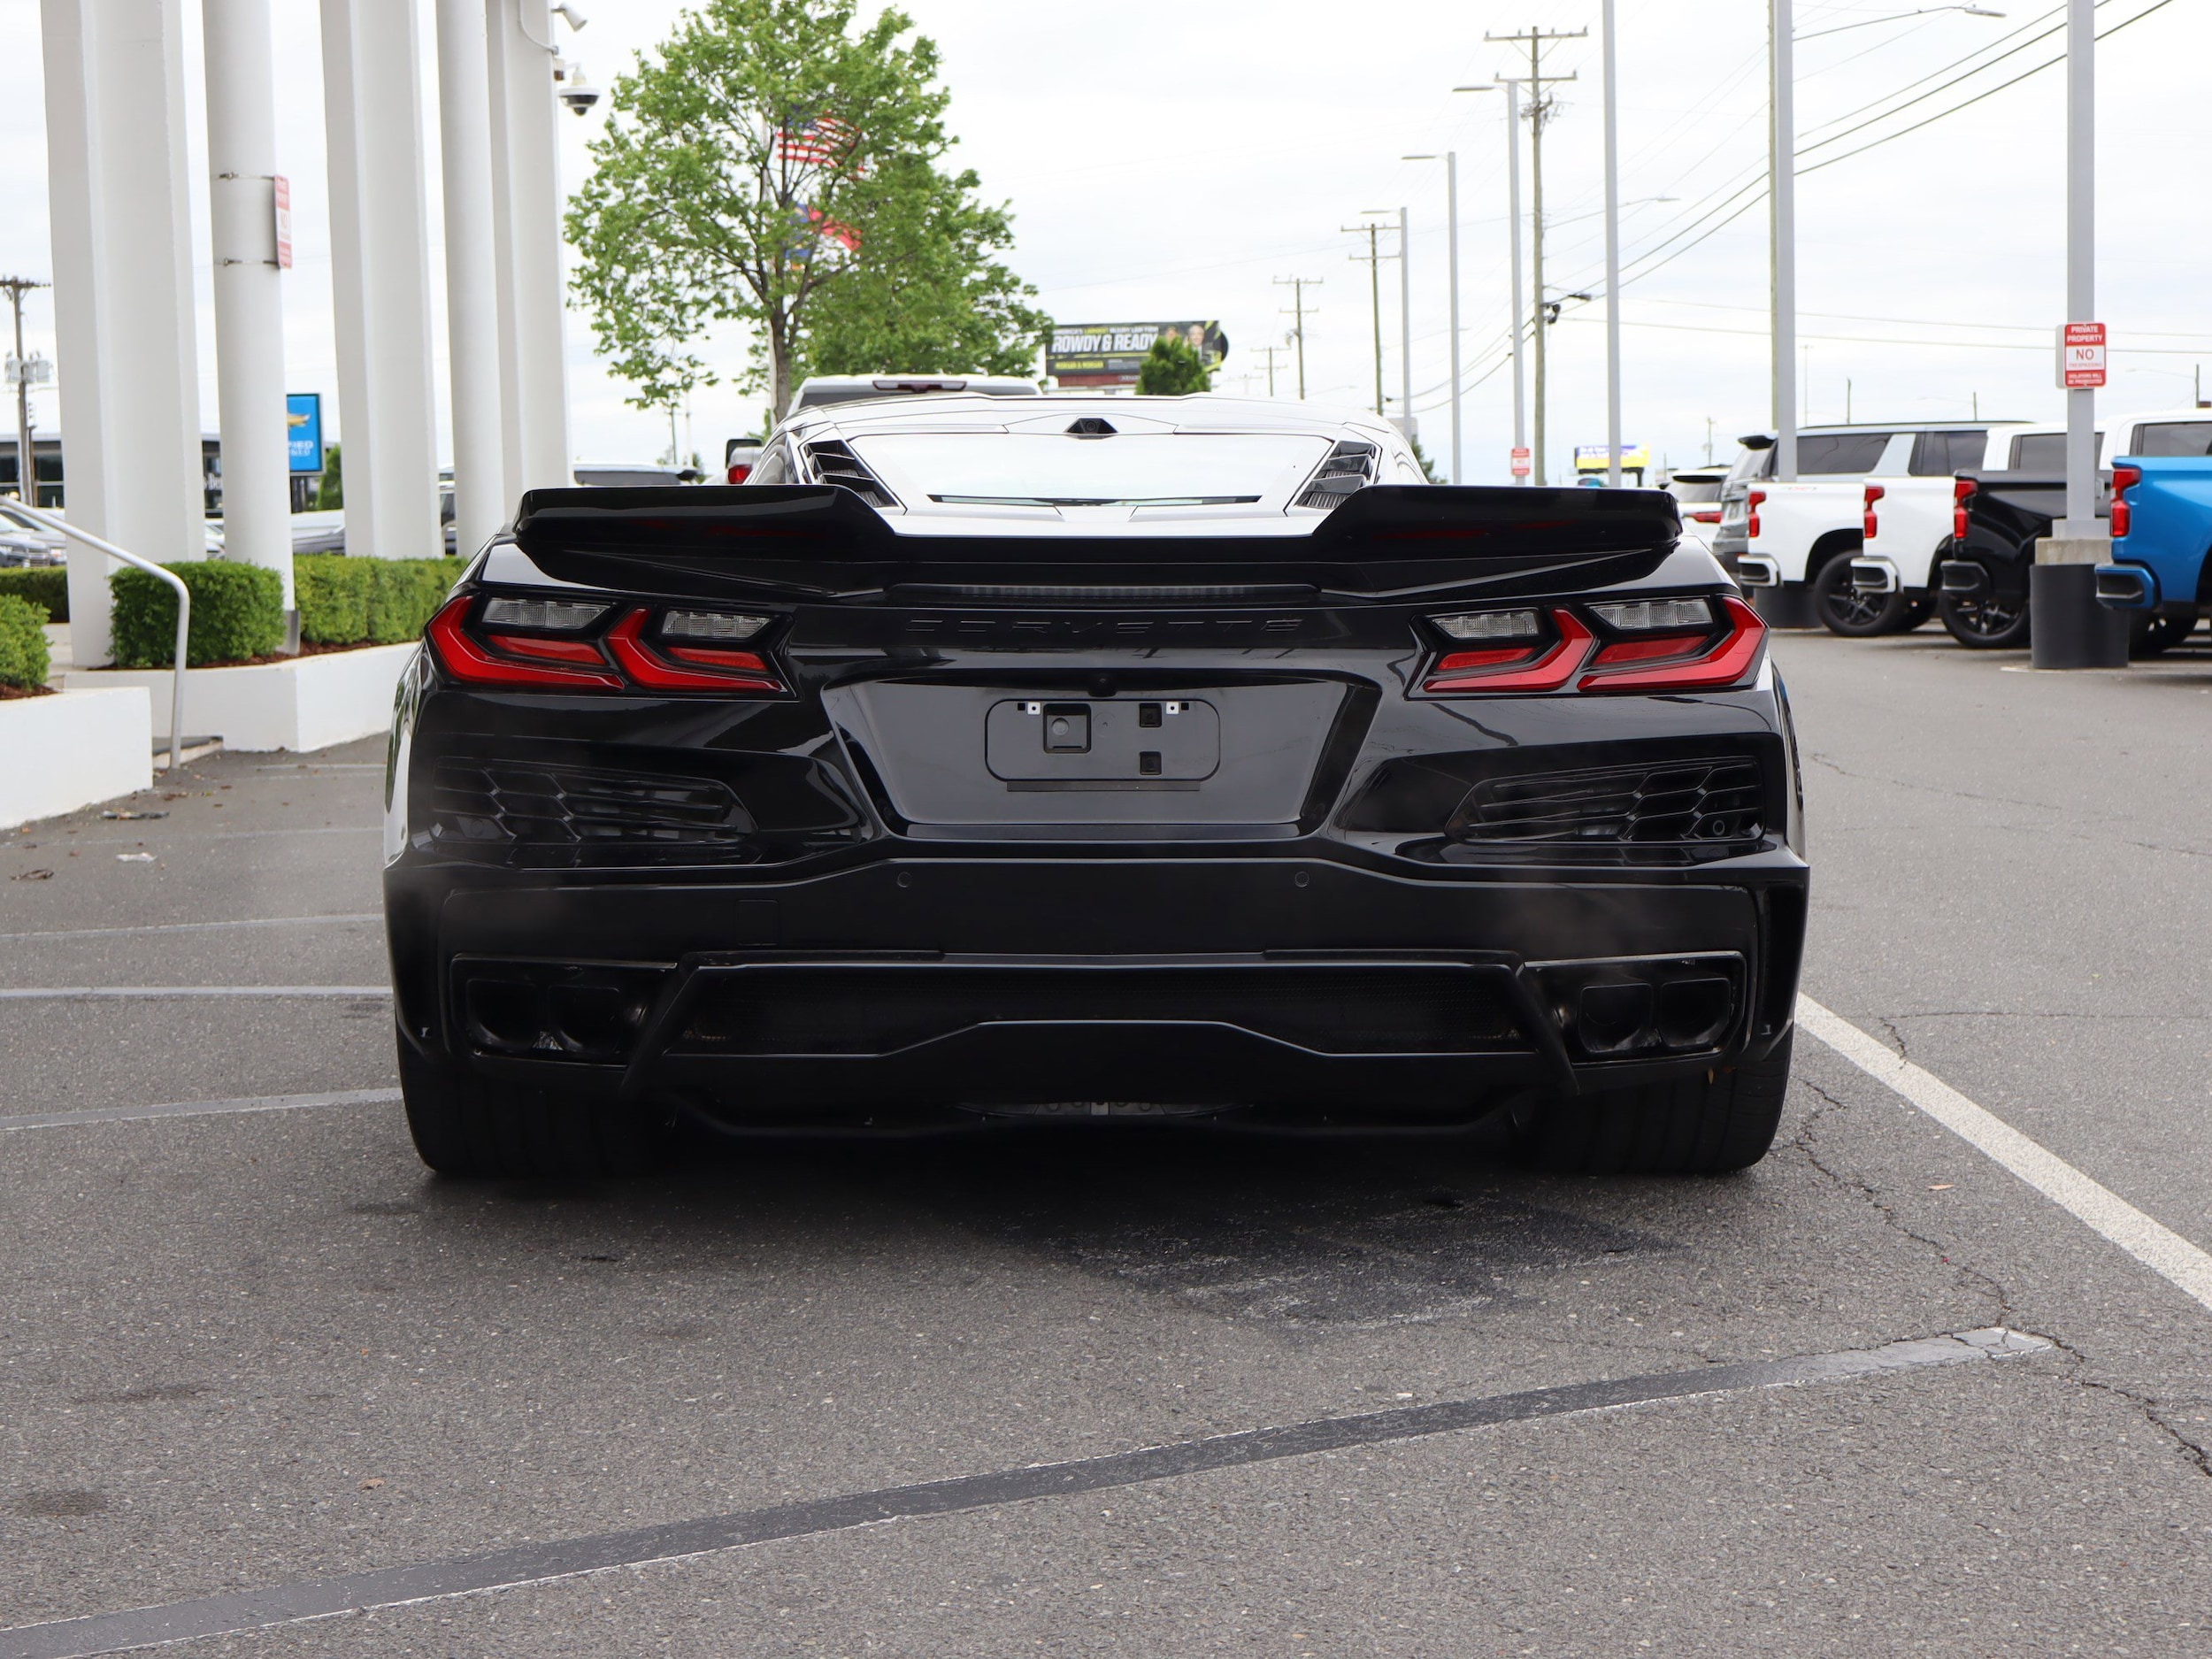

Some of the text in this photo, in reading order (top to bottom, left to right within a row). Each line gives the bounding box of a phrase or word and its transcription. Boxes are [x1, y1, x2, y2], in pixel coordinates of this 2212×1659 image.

[2071, 325, 2099, 334] PRIVATE
[1051, 334, 1102, 353] ROWDY
[1113, 333, 1158, 351] READY
[2067, 334, 2103, 343] PROPERTY
[2076, 348, 2094, 361] NO
[905, 618, 1303, 634] CORVETTE
